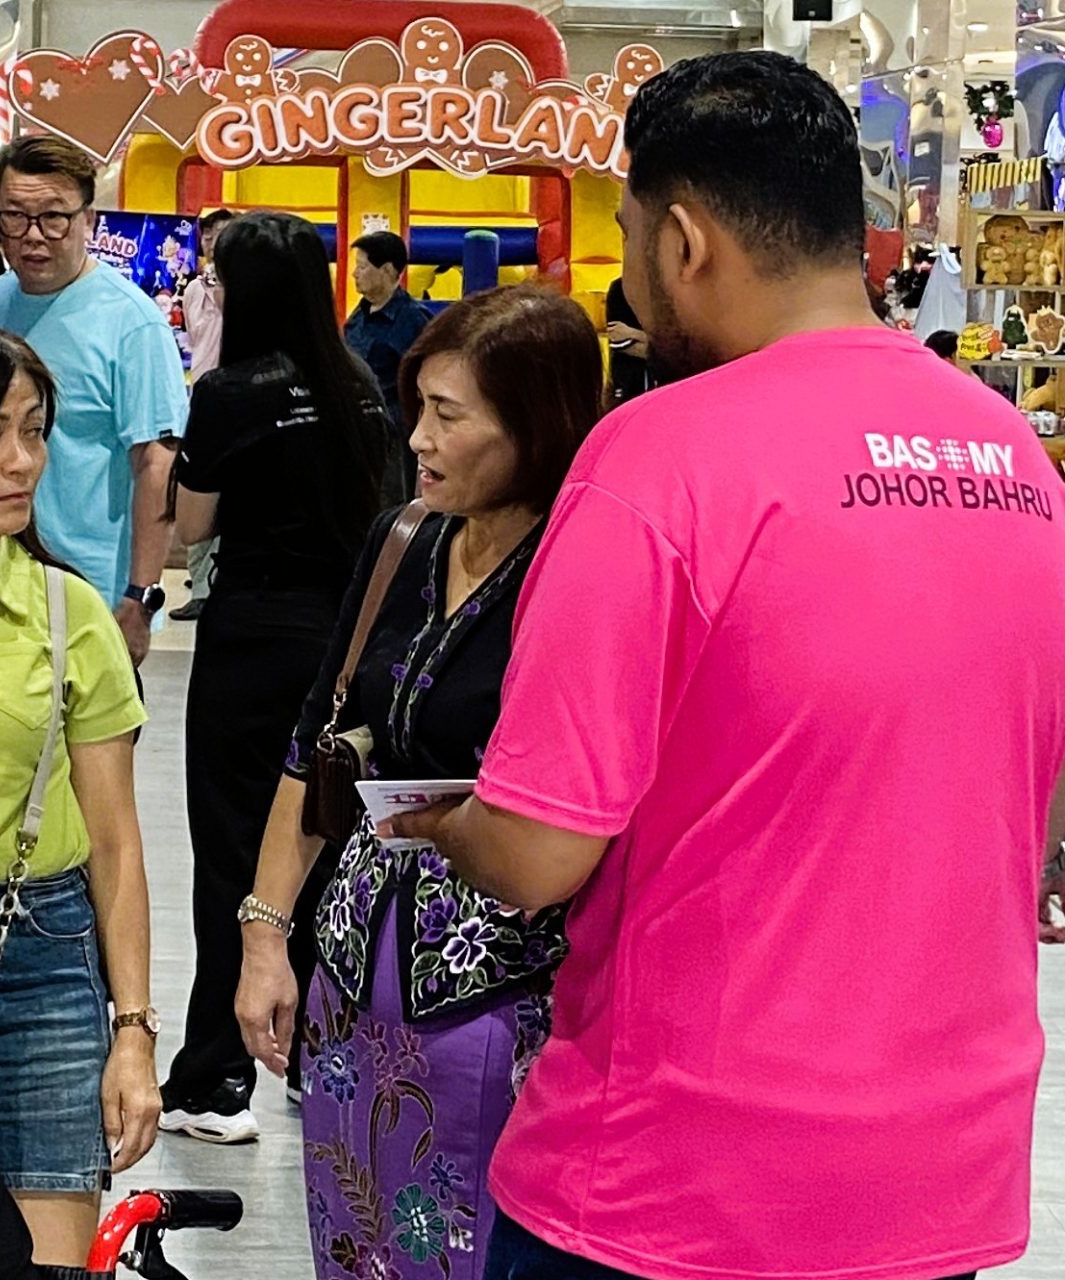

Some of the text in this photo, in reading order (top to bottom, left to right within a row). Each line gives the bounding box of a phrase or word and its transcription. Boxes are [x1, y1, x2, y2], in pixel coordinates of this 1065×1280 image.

[199, 86, 628, 178] GINGERLAN
[841, 473, 1054, 522] JOHOR BAHRU
